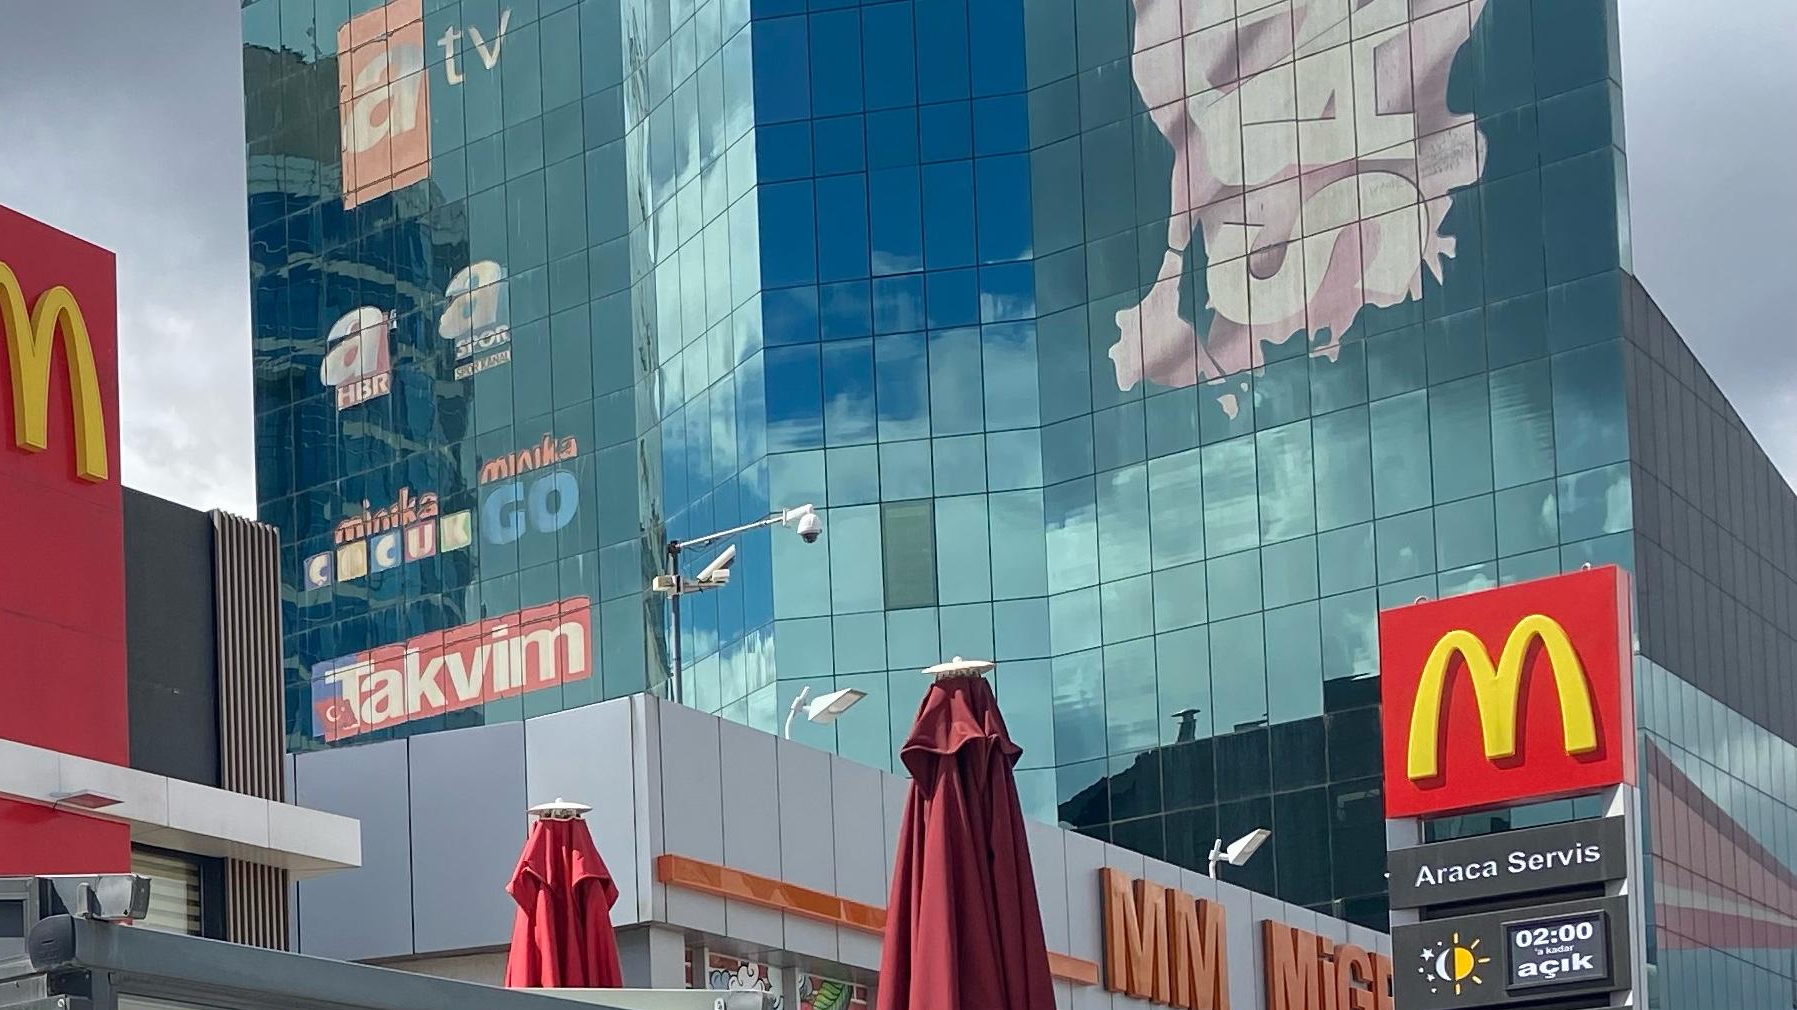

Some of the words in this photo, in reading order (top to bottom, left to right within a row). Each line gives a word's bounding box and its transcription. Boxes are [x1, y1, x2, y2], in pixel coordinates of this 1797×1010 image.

[437, 7, 513, 86] tv
[480, 432, 578, 485] minika
[334, 485, 439, 544] minika
[483, 468, 580, 545] GO
[324, 621, 586, 729] Takvim
[1415, 860, 1498, 887] Araca
[1507, 842, 1601, 874] Servis
[1516, 921, 1593, 948] 02:00
[1517, 952, 1594, 980] açık
